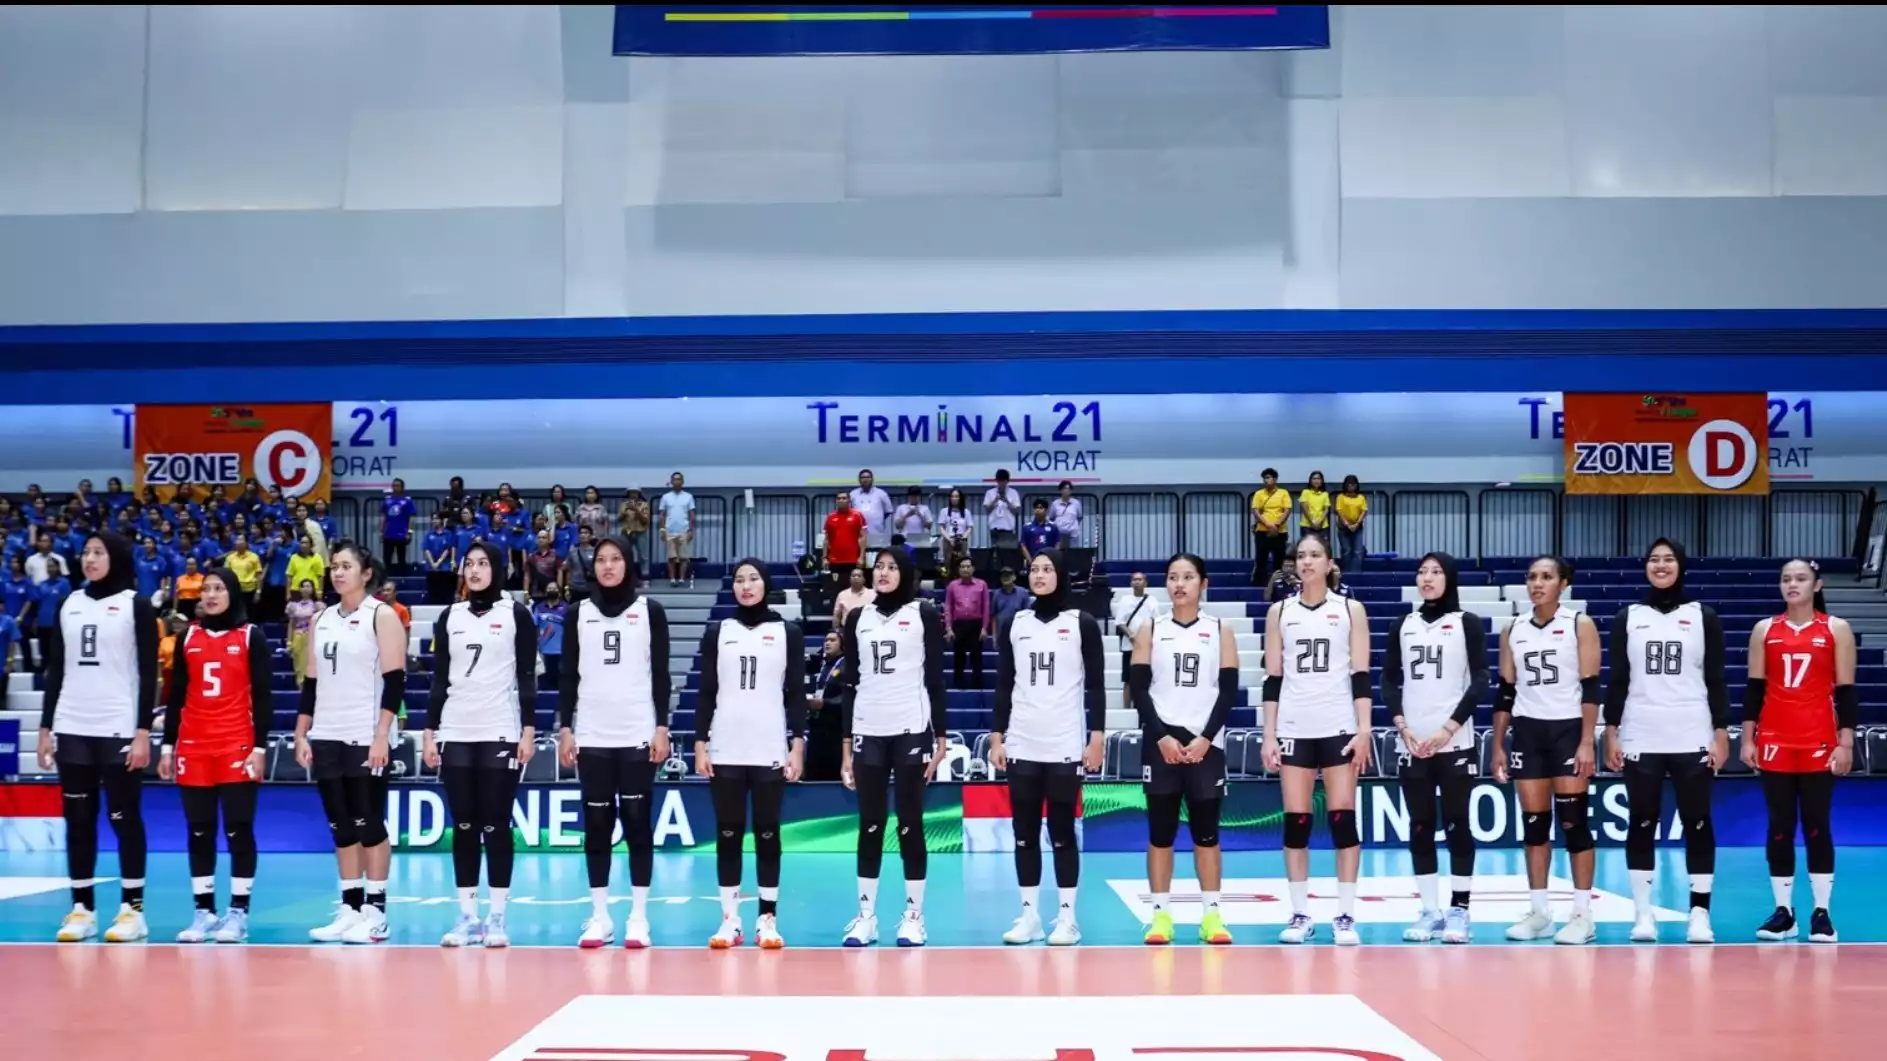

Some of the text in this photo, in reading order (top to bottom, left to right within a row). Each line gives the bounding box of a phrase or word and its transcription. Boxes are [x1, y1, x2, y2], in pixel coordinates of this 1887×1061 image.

[350, 407, 397, 447] 21
[806, 401, 1102, 443] TERMINAL 21
[1768, 398, 1813, 439] 21
[145, 441, 306, 488] ZONE C
[331, 455, 397, 477] ORAT
[1018, 450, 1102, 472] KORAT
[1575, 431, 1746, 477] ZONE D
[1769, 447, 1813, 468] RAT
[80, 624, 97, 658] 8
[323, 641, 338, 675] 4
[603, 630, 620, 665] 9
[870, 641, 897, 675] 12
[1296, 638, 1330, 673] 20
[1645, 640, 1683, 675] 88
[466, 643, 482, 677] 7
[740, 655, 756, 689] 11
[1029, 652, 1055, 686] 14
[1173, 653, 1200, 687] 19
[1410, 645, 1443, 679] 24
[1524, 649, 1559, 686] 55
[1782, 653, 1812, 688] 17
[202, 661, 221, 697] 5
[1280, 738, 1295, 756] 20
[1510, 752, 1523, 769] 55
[1763, 744, 1779, 761] 17
[177, 757, 185, 775] 5
